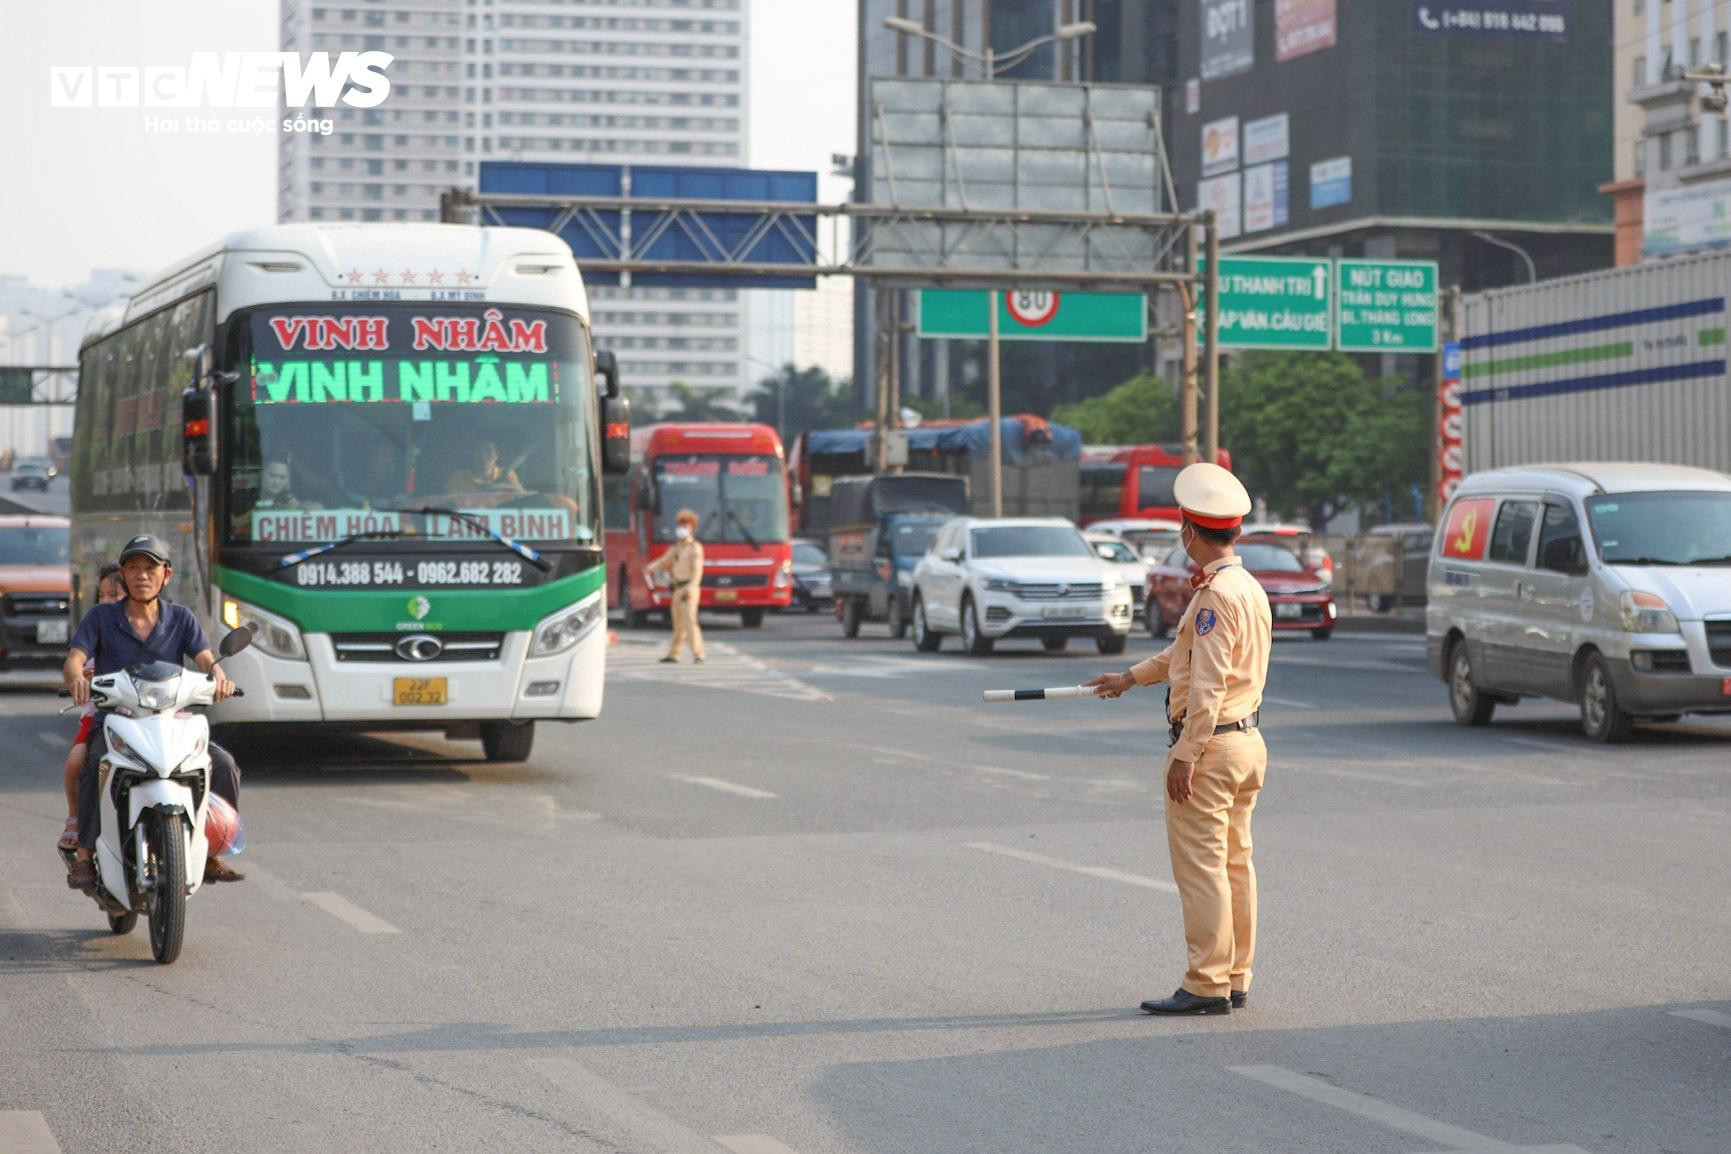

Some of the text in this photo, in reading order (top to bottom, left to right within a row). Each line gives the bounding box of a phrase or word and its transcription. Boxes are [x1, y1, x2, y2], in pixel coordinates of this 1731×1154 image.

[1233, 275, 1284, 295] THANH
[1386, 269, 1424, 289] GIAO
[1018, 289, 1048, 311] 80
[1375, 291, 1398, 307] DUY
[269, 308, 548, 353] VINH NHÂM
[256, 354, 548, 402] VINH NHÂM
[297, 562, 370, 586] 0914.388
[373, 562, 403, 584] 544
[417, 561, 489, 584] 0962.682
[492, 561, 522, 584] 282
